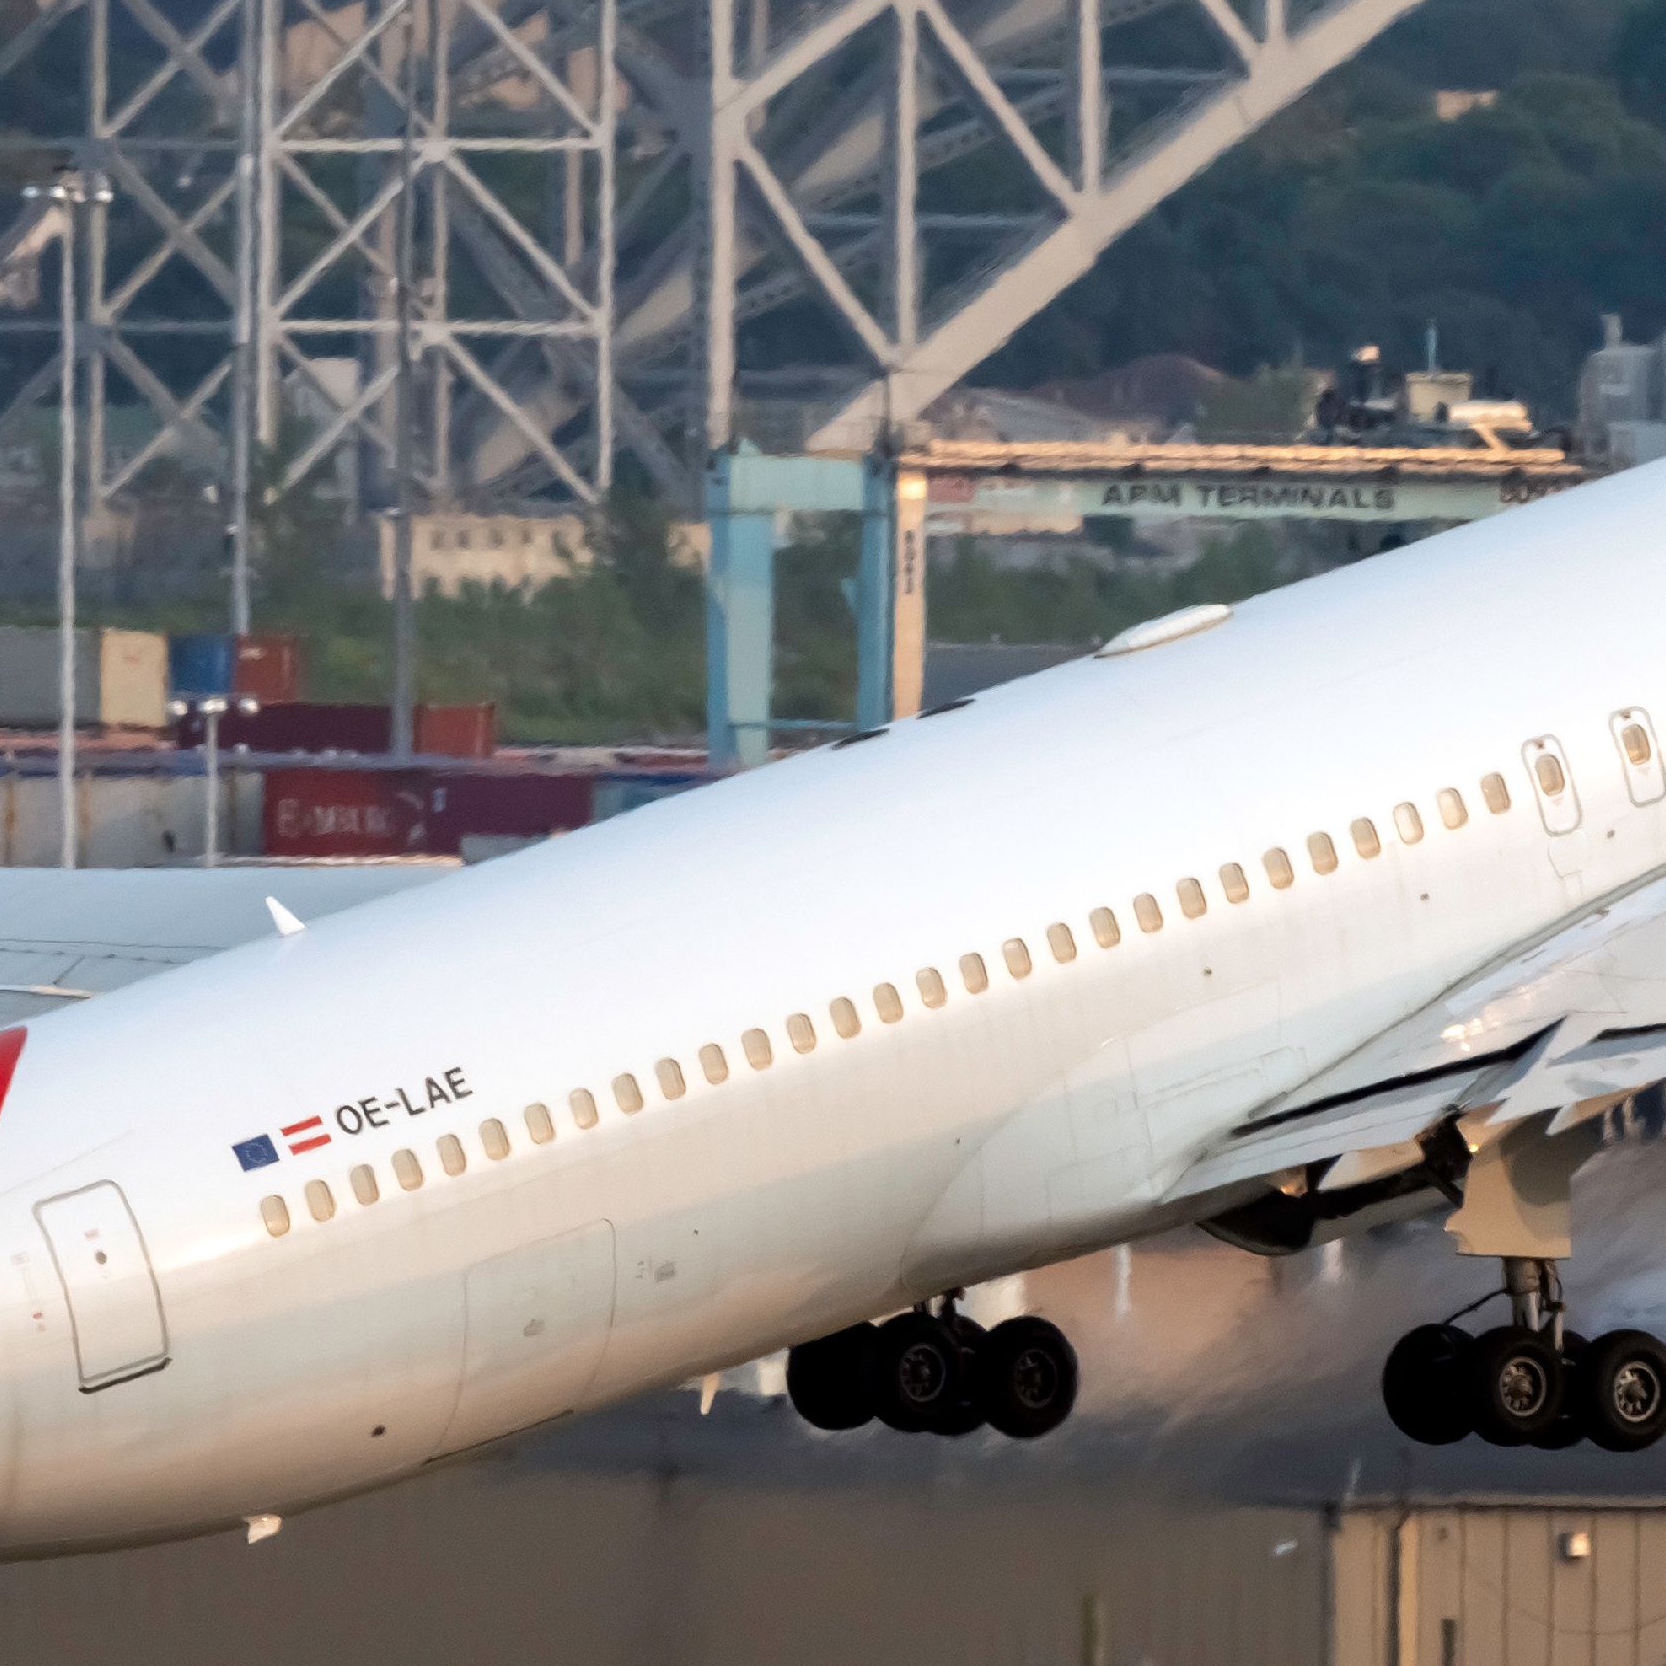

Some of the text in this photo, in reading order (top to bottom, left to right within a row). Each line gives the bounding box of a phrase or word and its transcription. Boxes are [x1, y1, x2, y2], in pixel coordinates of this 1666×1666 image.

[1101, 483, 1397, 510] APM TERMINALS
[336, 1066, 475, 1135] OE-LAE
